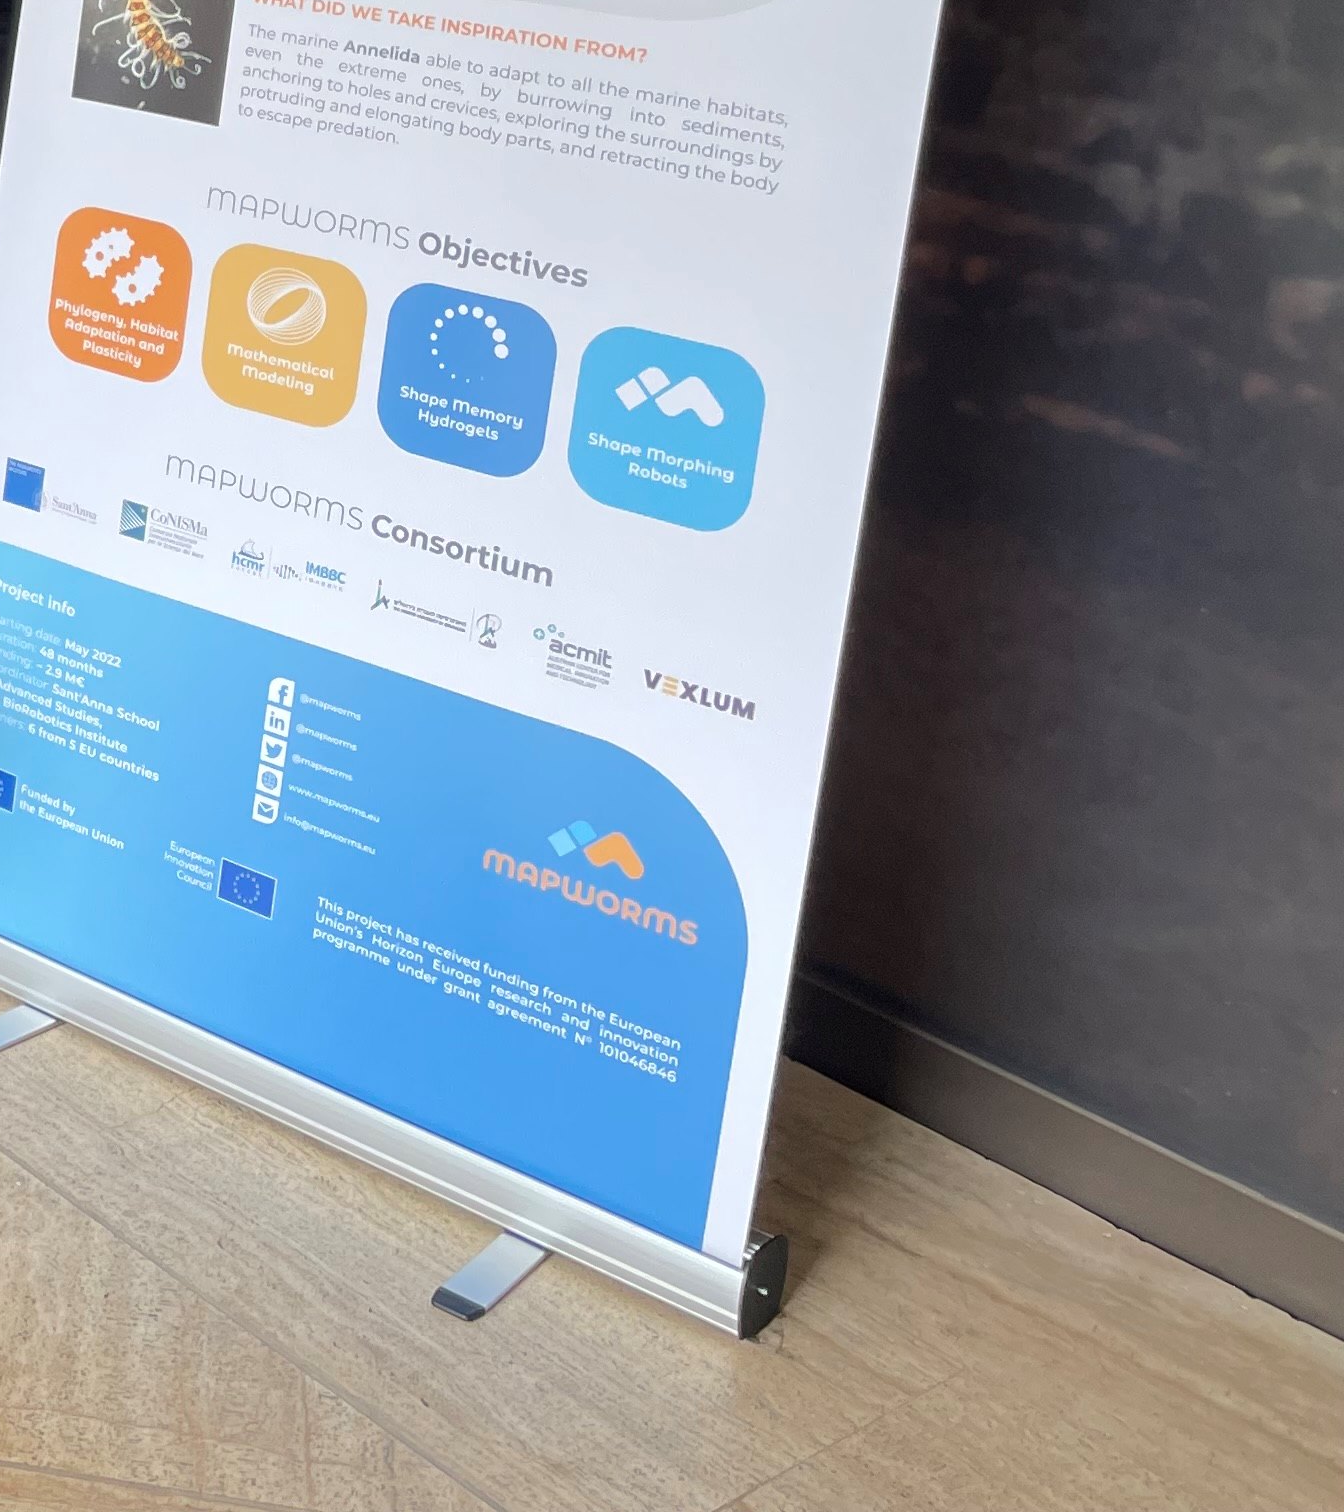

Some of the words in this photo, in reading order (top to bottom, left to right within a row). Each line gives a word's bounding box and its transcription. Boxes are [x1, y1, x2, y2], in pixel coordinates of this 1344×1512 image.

[351, 3, 382, 21] WE
[387, 9, 436, 30] TAKE
[440, 17, 567, 50] INSPIRATION
[574, 38, 647, 63] FROM?
[244, 46, 281, 61] even
[296, 52, 323, 68] the
[338, 61, 406, 82] extreme
[421, 75, 464, 95] ones,
[480, 81, 501, 101] by
[517, 88, 612, 120] burrowing
[630, 106, 665, 126] into
[681, 119, 784, 150] sediments,
[248, 23, 276, 40] The
[281, 32, 338, 50] marine
[342, 39, 420, 64] Annelida
[425, 52, 461, 71] able
[467, 59, 483, 74] to
[488, 64, 540, 85] adapt
[547, 72, 565, 87] to
[571, 76, 592, 92] all
[598, 80, 629, 98] the
[635, 89, 700, 110] marine
[706, 96, 787, 128] habitats,
[238, 103, 253, 117] to
[256, 108, 312, 128] escape
[316, 119, 399, 144] predation.
[239, 85, 325, 113] protruding
[329, 101, 361, 116] and
[364, 106, 454, 136] elongating
[458, 120, 502, 144] body
[505, 133, 554, 154] parts,
[559, 142, 595, 158] and
[599, 149, 690, 179] retracting
[695, 164, 725, 182] the
[730, 169, 779, 195] body
[242, 65, 322, 92] anchoring
[326, 78, 343, 92] to
[347, 80, 390, 101] holes
[394, 92, 426, 107] and
[430, 98, 500, 123] crevices,
[504, 111, 589, 139] exploring
[595, 124, 625, 142] the
[629, 132, 753, 166] surroundings
[759, 151, 783, 173] by
[206, 186, 409, 249] MAPWORMS
[418, 231, 587, 287] Objectives
[54, 298, 126, 328] Phylogeny,
[130, 318, 178, 341] Habitat
[64, 317, 135, 346] Adaptation
[138, 340, 164, 354] and
[82, 339, 141, 368] Plasticity
[227, 342, 333, 380] Mathematical
[241, 364, 314, 395] Modeling
[399, 385, 448, 408] Shape
[452, 398, 523, 430] Memory
[418, 408, 498, 440] Hydrogels
[587, 432, 641, 456] Shape
[646, 446, 734, 483] Morphing
[628, 461, 687, 488] Robots
[150, 508, 208, 537] CoNISMa
[165, 454, 363, 530] MAPWORMS
[371, 514, 552, 587] Consortium
[231, 551, 265, 572] hcmr
[305, 560, 347, 585] IMBBC
[64, 638, 89, 656] May
[91, 648, 121, 667] 2022
[549, 638, 612, 669] acmit
[644, 669, 756, 720] VEXLUM
[482, 849, 697, 944] MAPWORMS
[315, 911, 362, 939] Union's
[371, 933, 423, 963] Horizon
[432, 958, 481, 987] Europe
[490, 984, 551, 1015] research
[561, 1012, 590, 1030] and
[599, 1024, 678, 1066] innovation
[317, 896, 343, 915] This
[345, 910, 392, 936] project
[395, 927, 419, 946] has
[422, 940, 480, 971] received
[482, 962, 538, 996] funding
[542, 986, 577, 1009] from
[581, 1001, 605, 1020] the
[609, 1012, 680, 1050] European
[312, 927, 390, 965] programme
[396, 961, 438, 984] under
[443, 981, 480, 1003] grant
[487, 999, 566, 1039] agreement
[599, 1041, 676, 1082] 101046846
